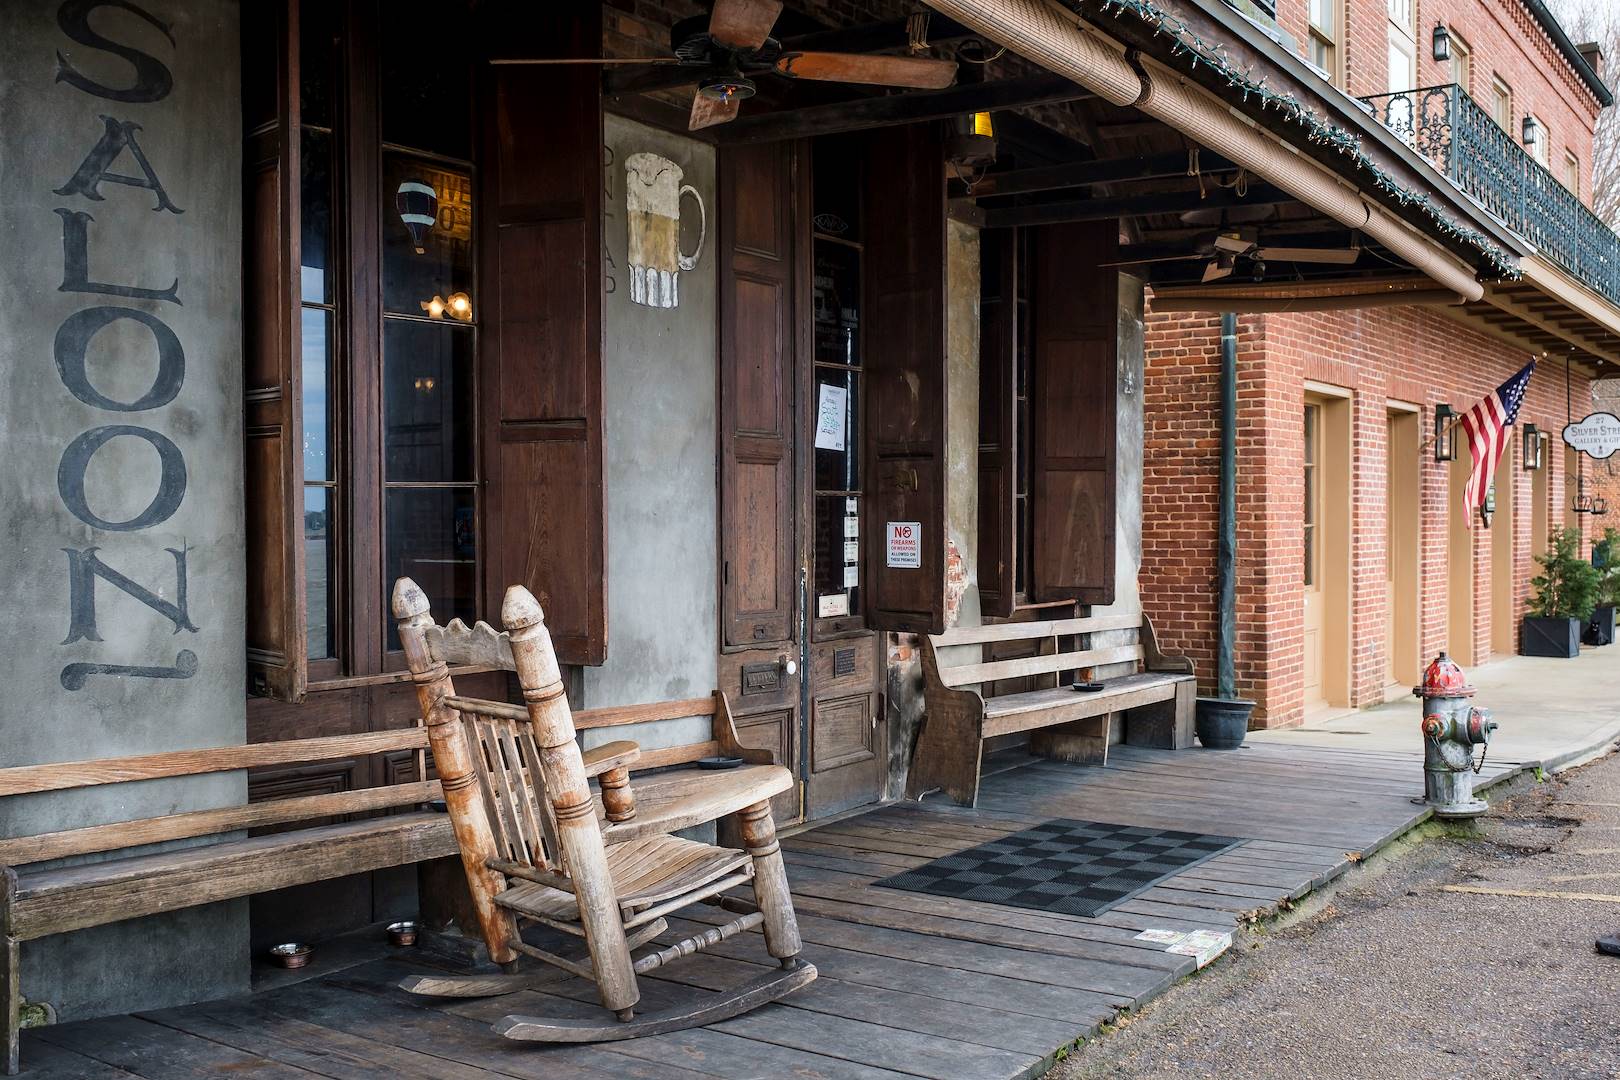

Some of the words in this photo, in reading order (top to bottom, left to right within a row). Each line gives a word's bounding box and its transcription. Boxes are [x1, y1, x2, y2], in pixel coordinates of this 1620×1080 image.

[53, 0, 200, 645] SALOON
[1571, 427, 1598, 436] SILVER
[895, 526, 911, 538] NO
